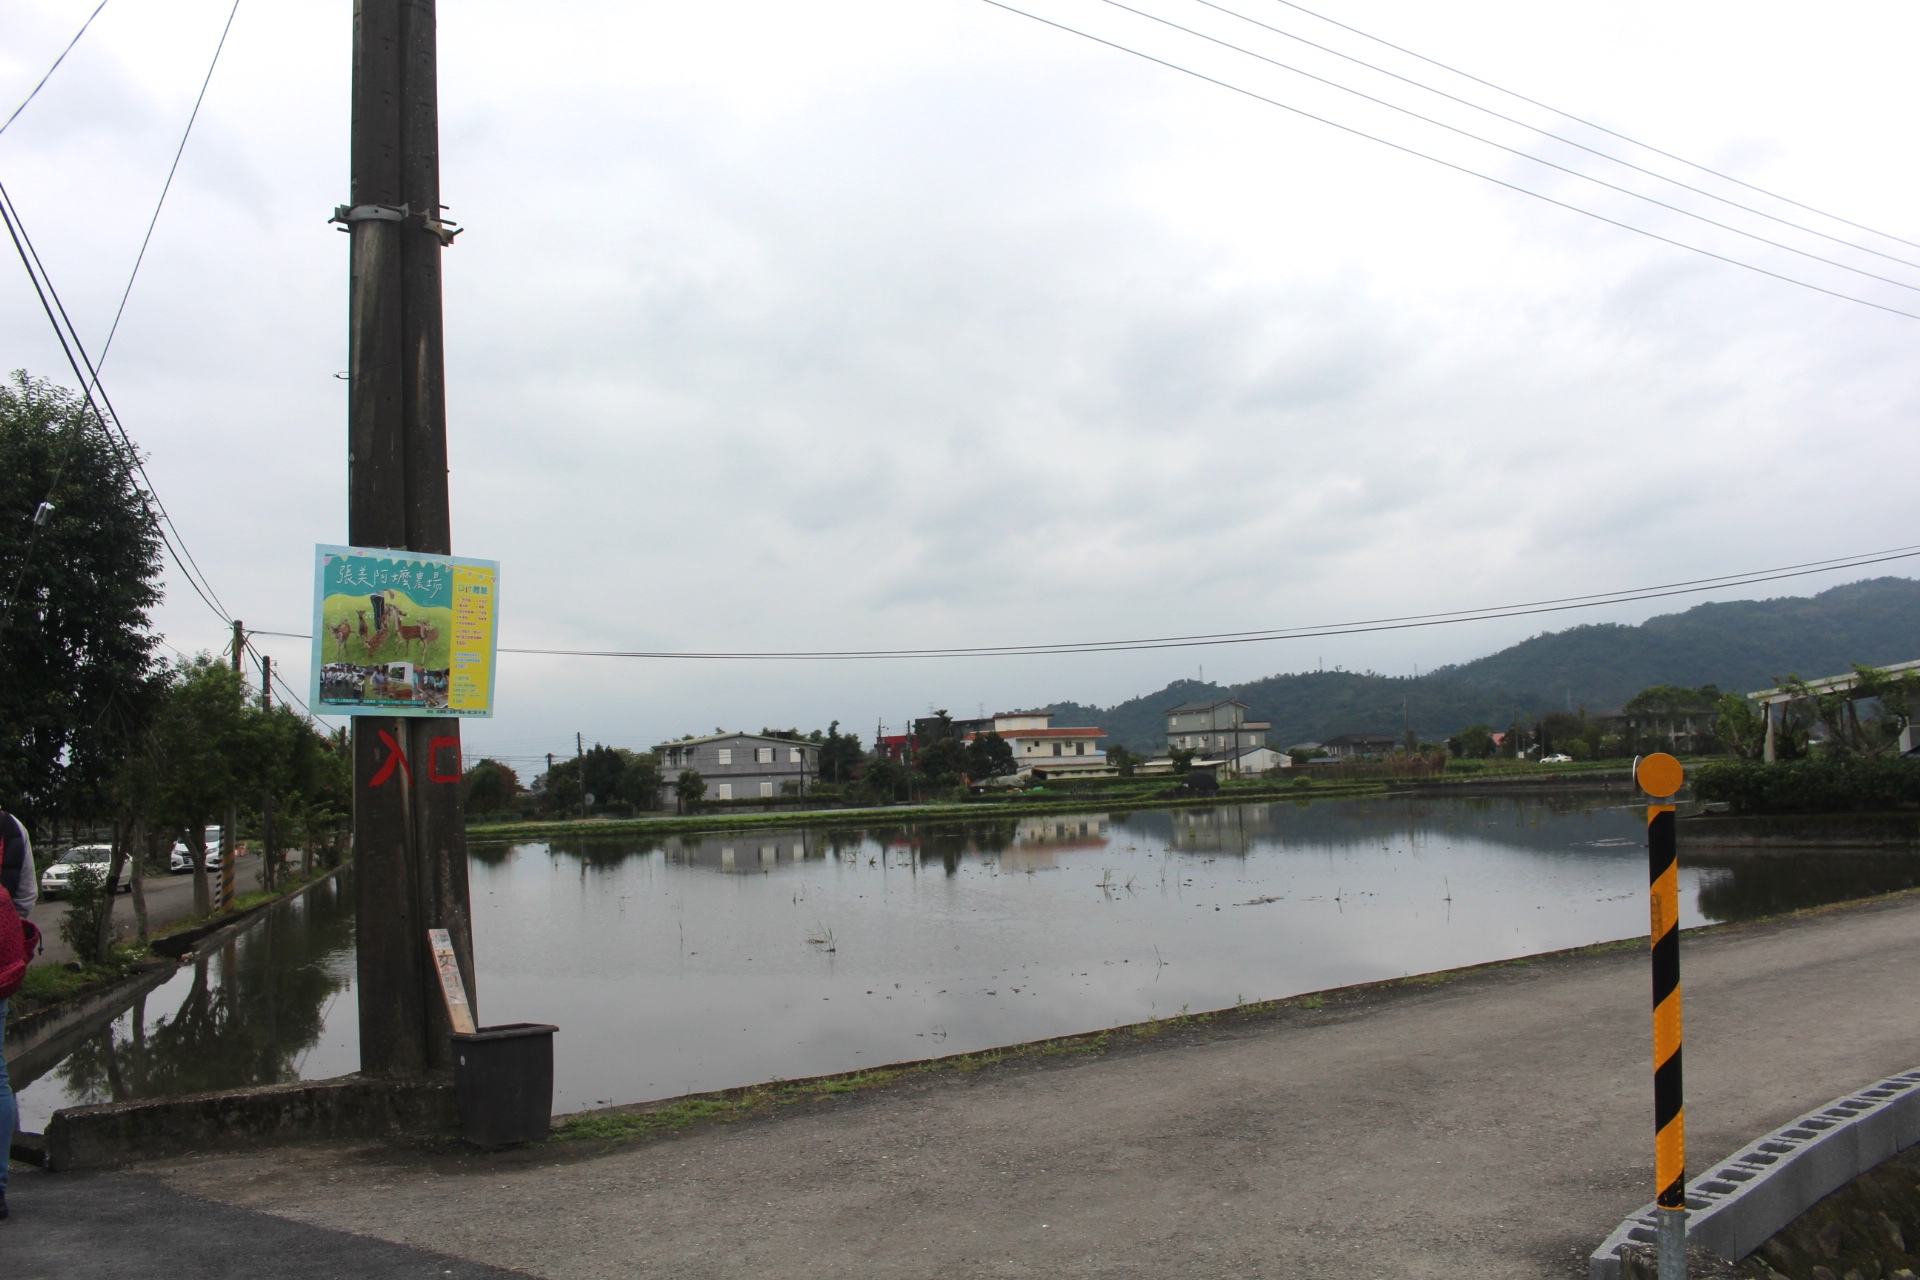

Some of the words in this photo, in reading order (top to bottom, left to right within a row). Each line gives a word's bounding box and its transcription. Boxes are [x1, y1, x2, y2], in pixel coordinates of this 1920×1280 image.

[337, 564, 442, 598] 張美阿嬤農場
